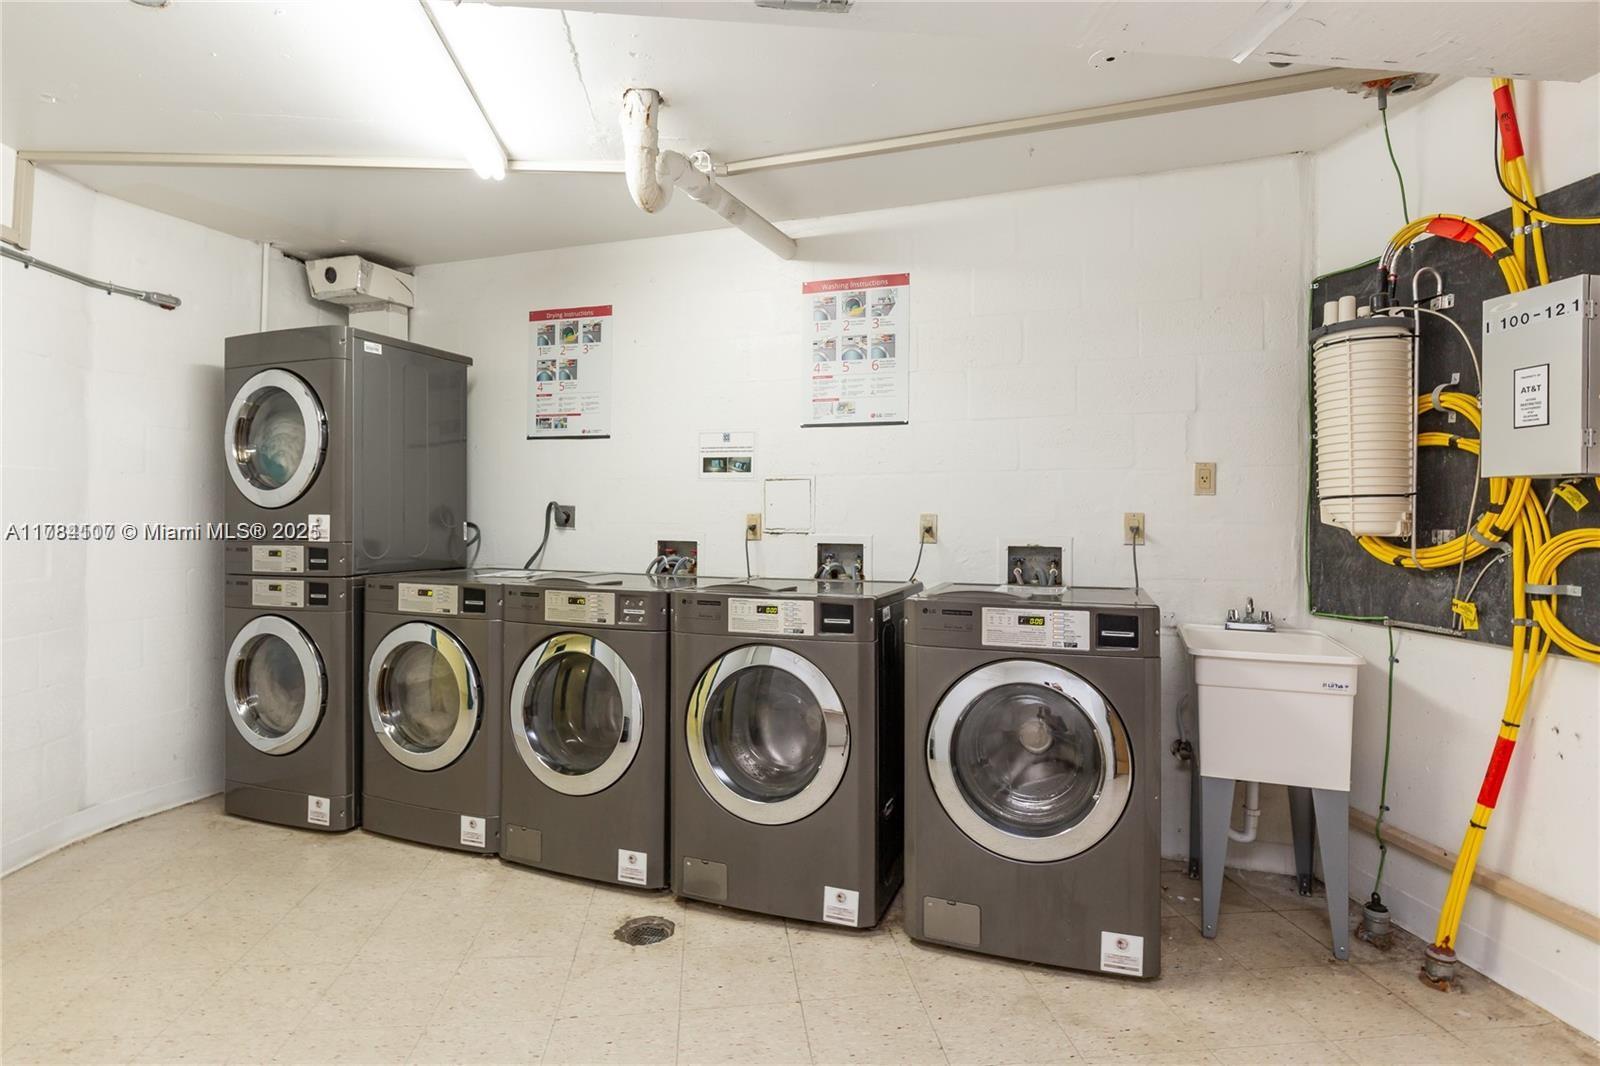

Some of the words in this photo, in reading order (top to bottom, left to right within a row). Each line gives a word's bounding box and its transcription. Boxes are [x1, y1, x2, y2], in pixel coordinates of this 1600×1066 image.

[850, 279, 889, 289] Instructions
[546, 312, 564, 320] Drying
[564, 310, 594, 319] Instructions
[843, 320, 850, 331] 2
[872, 318, 880, 329] 3
[560, 345, 566, 355] 2
[583, 344, 589, 354] 3
[813, 362, 821, 373] 4
[842, 361, 850, 372] 5
[871, 360, 879, 371] 6
[537, 382, 543, 392] 4
[560, 381, 565, 391] 5
[1521, 384, 1541, 394] AT&T
